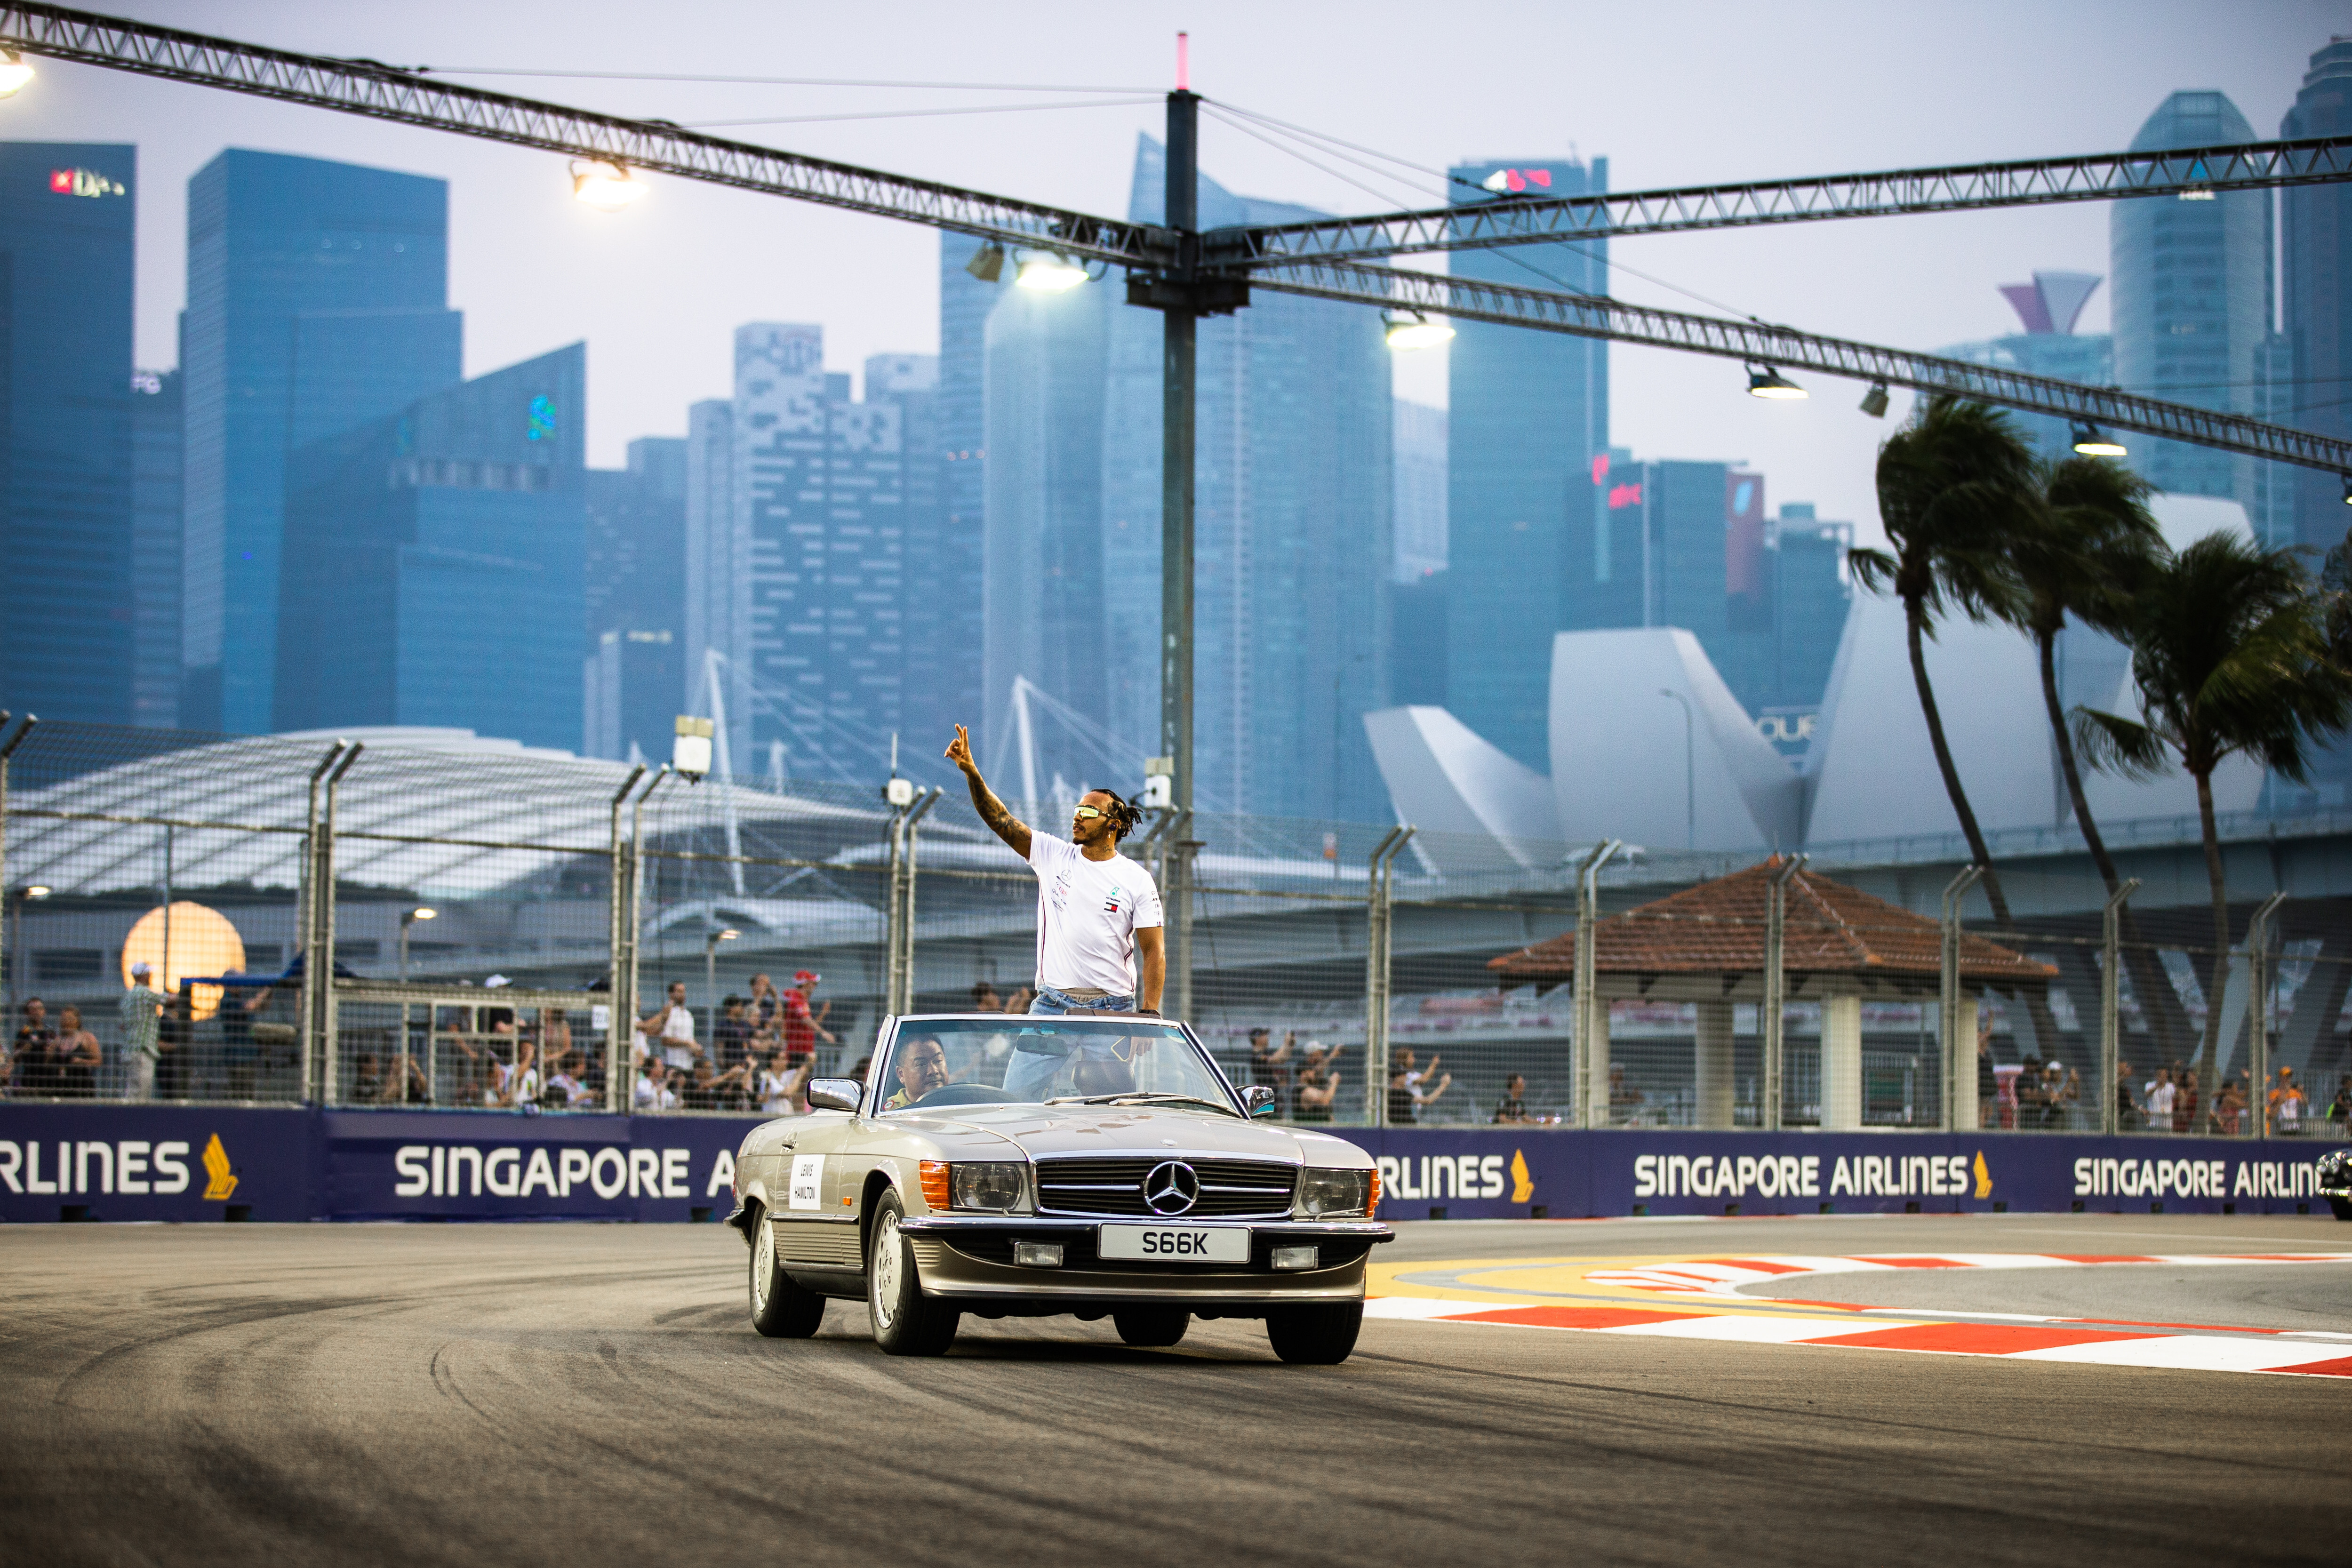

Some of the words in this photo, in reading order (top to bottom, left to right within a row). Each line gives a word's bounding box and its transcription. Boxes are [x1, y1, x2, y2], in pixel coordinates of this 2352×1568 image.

[0, 1141, 190, 1194] RLINES
[395, 1146, 691, 1200] SINGAPORE
[800, 1164, 814, 1177] LEWIS
[1376, 1155, 1505, 1200] RLINES
[1634, 1155, 1821, 1198] SINGAPORE
[1830, 1156, 1968, 1197] AIRLINES
[2074, 1158, 2226, 1198] SINGAPORE
[2233, 1161, 2322, 1199] AIRLIN
[794, 1186, 816, 1200] HAMILTON
[1142, 1232, 1208, 1254] S66K
